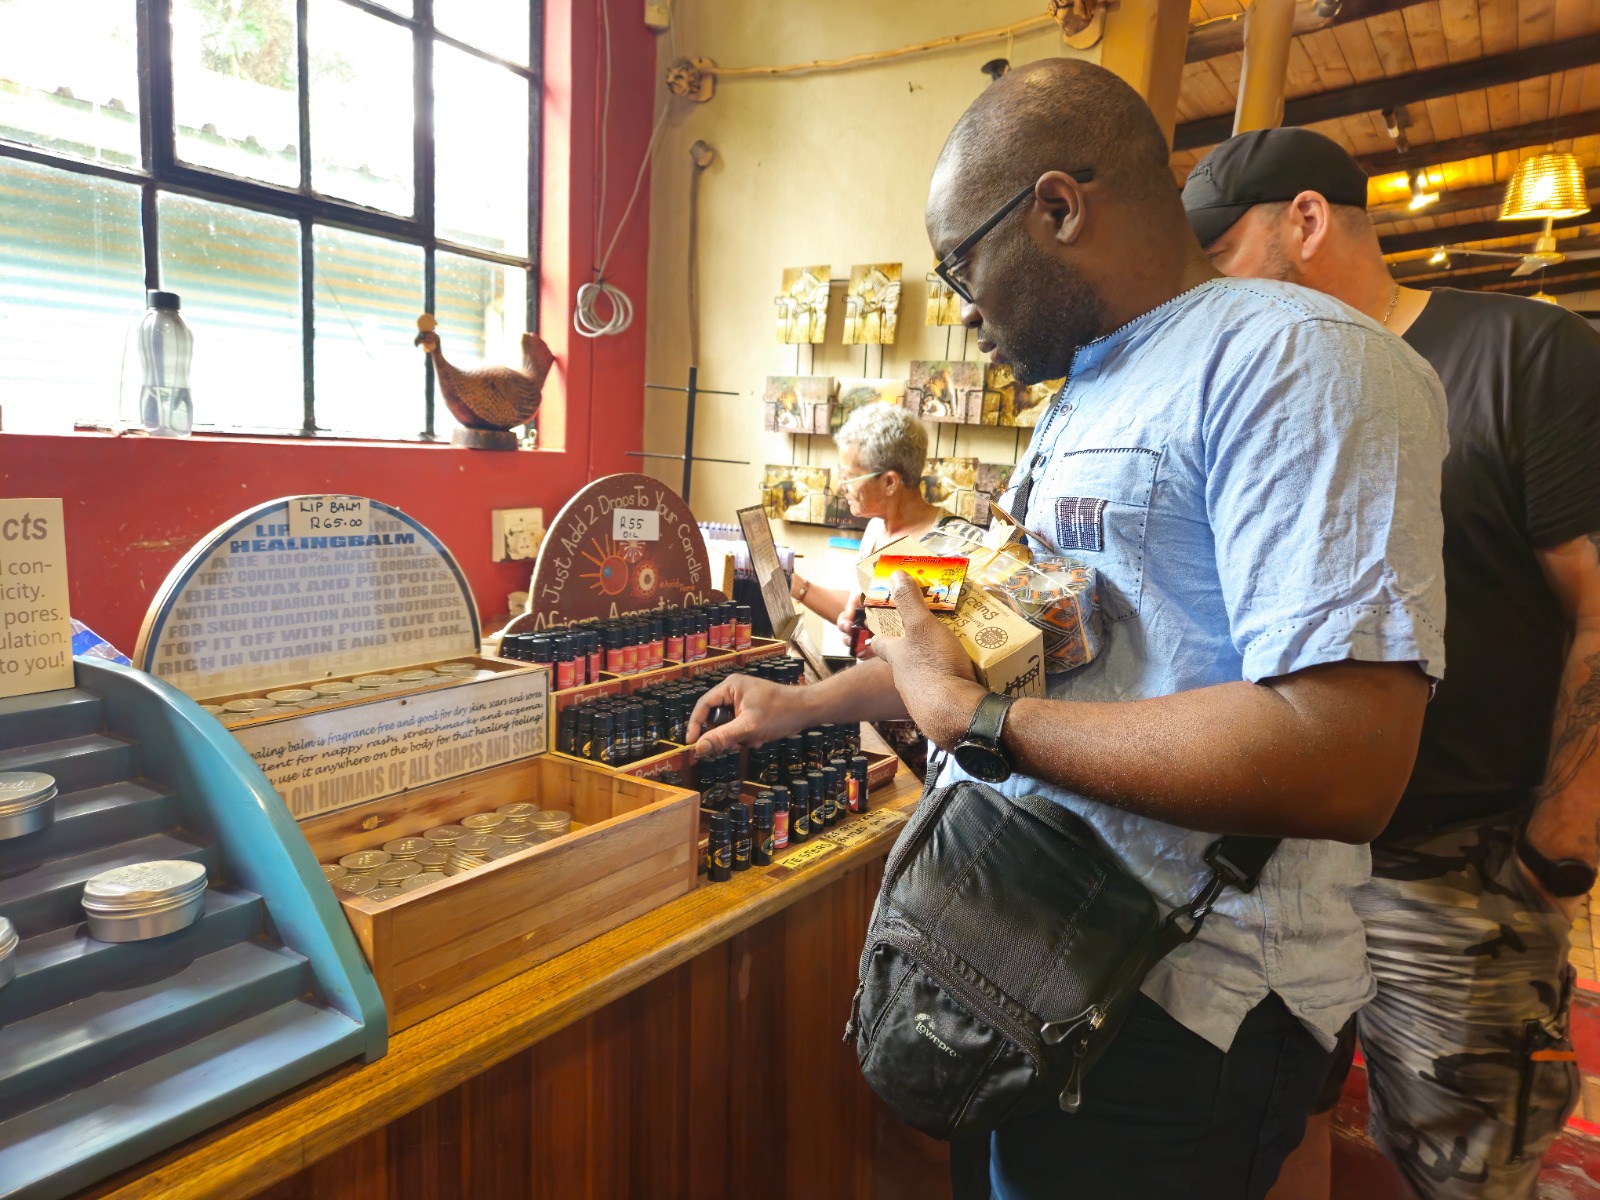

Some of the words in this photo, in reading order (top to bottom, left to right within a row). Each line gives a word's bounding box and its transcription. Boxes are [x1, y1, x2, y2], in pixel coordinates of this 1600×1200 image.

[300, 501, 323, 513] LIP
[330, 502, 361, 513] BALM
[620, 516, 645, 530] R55
[623, 531, 639, 539] OIL
[230, 533, 415, 554] HEALINGBALM
[541, 557, 572, 604] Just
[561, 514, 588, 556] Add
[583, 504, 599, 526] 2
[633, 485, 649, 507] To
[654, 490, 678, 525] Your
[677, 523, 703, 585] Candle
[210, 555, 259, 570] ARE
[265, 551, 330, 566] 100%
[198, 570, 234, 586] THEY
[237, 566, 296, 583] CONTAIN
[299, 563, 354, 579] ORGANIC
[357, 561, 378, 574] BEE
[176, 604, 217, 620] WITH
[221, 600, 268, 617] ADDED
[270, 594, 325, 612] MARULA
[352, 589, 381, 604] RICH
[383, 588, 396, 600] IN
[398, 585, 429, 599] OLEIC
[430, 583, 457, 596] ACID
[184, 581, 302, 603] BEESWAX
[306, 577, 350, 593] AND
[4, 607, 64, 630] pores.
[962, 596, 1000, 620] Swazi
[161, 640, 208, 657] TOP
[213, 635, 234, 651] IT
[239, 631, 276, 647] OFF
[281, 624, 334, 643] WITH
[338, 618, 385, 636] PURE
[389, 612, 435, 629] OLIVE
[168, 623, 203, 639] FOR
[207, 618, 248, 635] SKIN
[252, 608, 339, 630] HYDRATION
[342, 605, 371, 620] AND
[25, 651, 65, 676] you!
[157, 655, 216, 676] RICH
[221, 652, 244, 668] IN
[248, 640, 333, 663] VITAMIN
[337, 638, 347, 651] E
[350, 633, 388, 649] AND
[391, 628, 424, 643] YOU
[288, 739, 316, 753] balm
[317, 737, 327, 748] is
[327, 725, 377, 746] fragrance
[377, 722, 396, 737] free
[396, 718, 417, 729] and
[416, 710, 439, 728] good
[439, 708, 453, 721] for
[453, 705, 468, 717] dry
[488, 698, 508, 709] scars
[508, 692, 526, 704] and
[296, 754, 318, 767] for
[321, 743, 363, 758] nappy
[402, 716, 479, 741] stretchmarks
[479, 711, 504, 724] and
[278, 772, 301, 785] use
[302, 768, 315, 779] it
[314, 756, 373, 776] anywhere
[372, 752, 389, 761] on
[390, 745, 410, 757] the
[410, 739, 435, 753] body
[436, 735, 451, 748] for
[452, 730, 474, 742] that
[474, 721, 511, 737] healing
[291, 783, 314, 817] ON
[318, 765, 386, 810] HUMANS
[388, 760, 406, 790] OF
[408, 753, 432, 786] ALL
[434, 740, 483, 778] SHAPES
[486, 734, 511, 764] AND
[512, 725, 544, 757] SIZES
[782, 843, 832, 866] TESTERS
